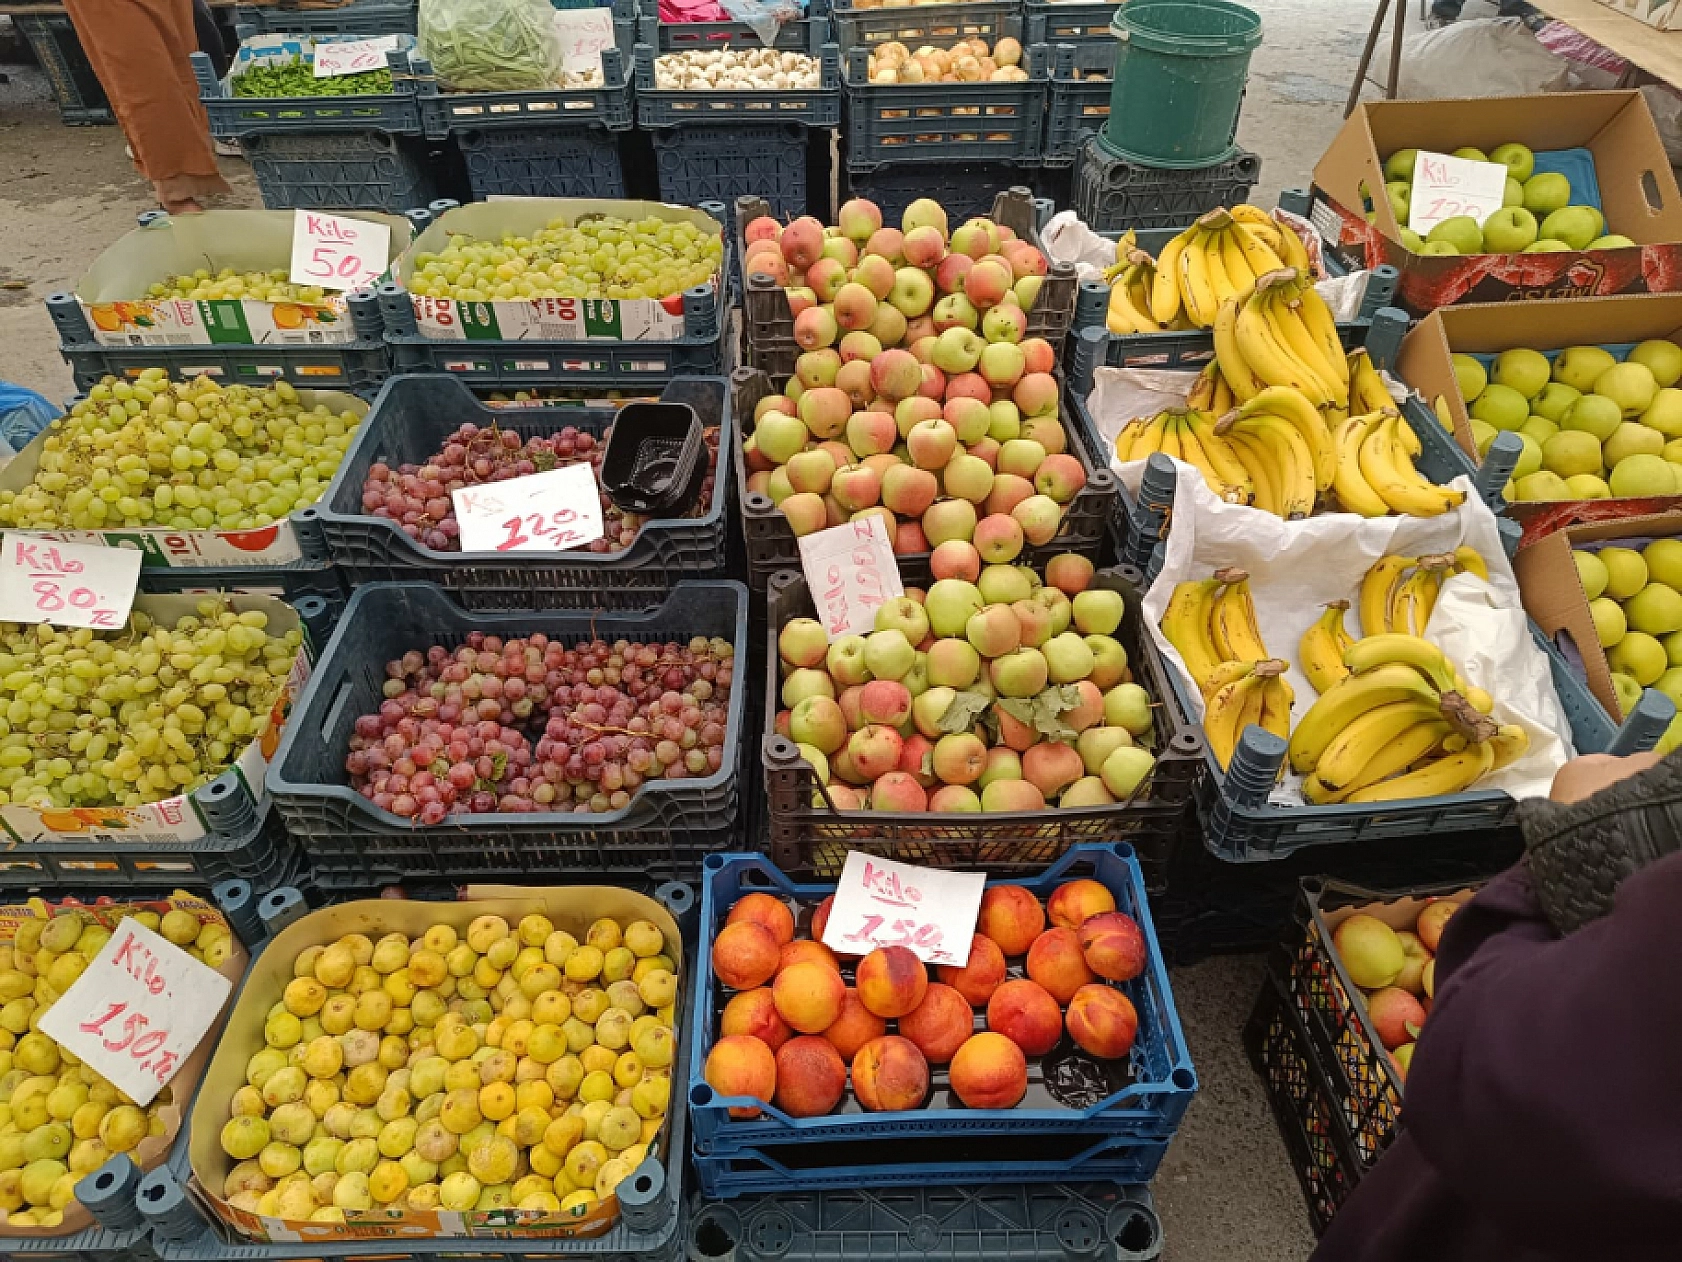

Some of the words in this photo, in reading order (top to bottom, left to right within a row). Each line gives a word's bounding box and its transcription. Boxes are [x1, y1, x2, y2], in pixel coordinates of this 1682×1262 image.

[307, 214, 358, 240] Kilo
[15, 541, 85, 574] Kilo
[862, 860, 923, 902] Kilo
